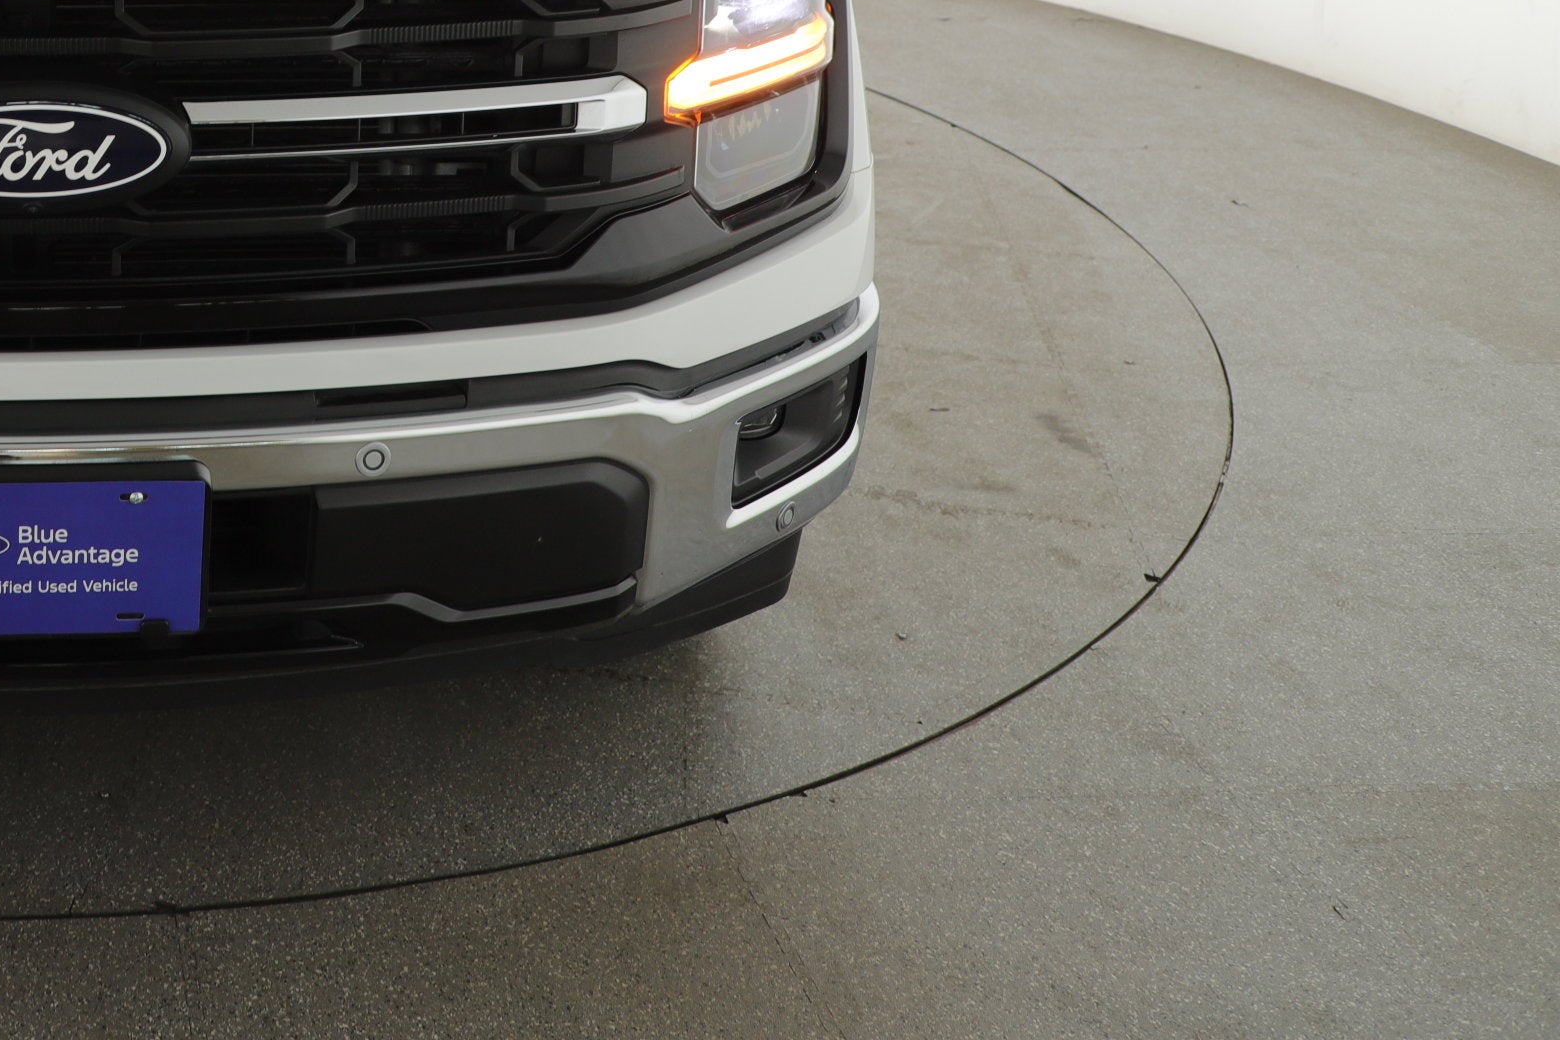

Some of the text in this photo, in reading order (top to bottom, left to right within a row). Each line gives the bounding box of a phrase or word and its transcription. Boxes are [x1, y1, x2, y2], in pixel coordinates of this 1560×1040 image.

[17, 525, 68, 544] Blue
[16, 545, 139, 567] Advantage
[38, 580, 77, 594] Used
[82, 578, 138, 593] Vehicle
